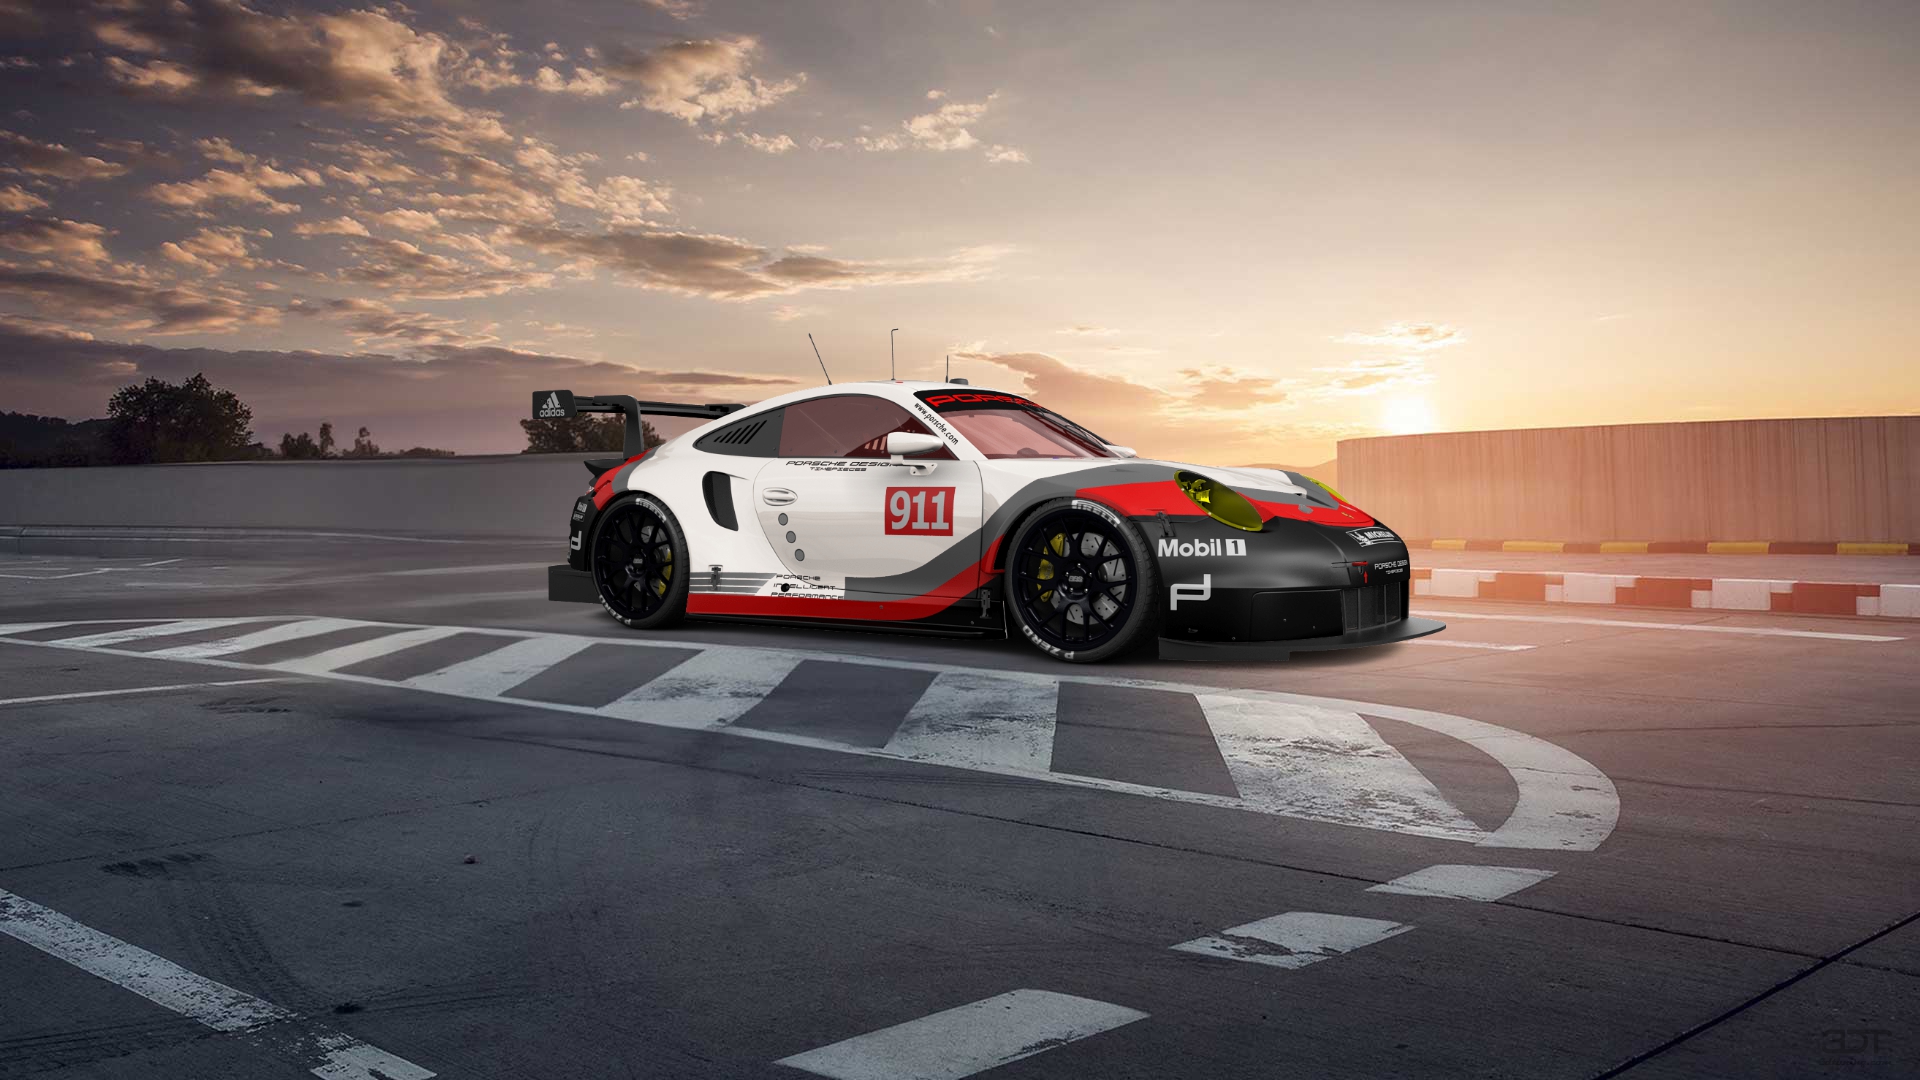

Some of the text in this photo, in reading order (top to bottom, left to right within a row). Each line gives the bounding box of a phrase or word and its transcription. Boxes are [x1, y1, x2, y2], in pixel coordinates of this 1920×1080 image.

[539, 408, 565, 417] adidas
[914, 402, 959, 445] www.porsche.com
[889, 490, 950, 530] 911
[1158, 538, 1222, 557] Mobil
